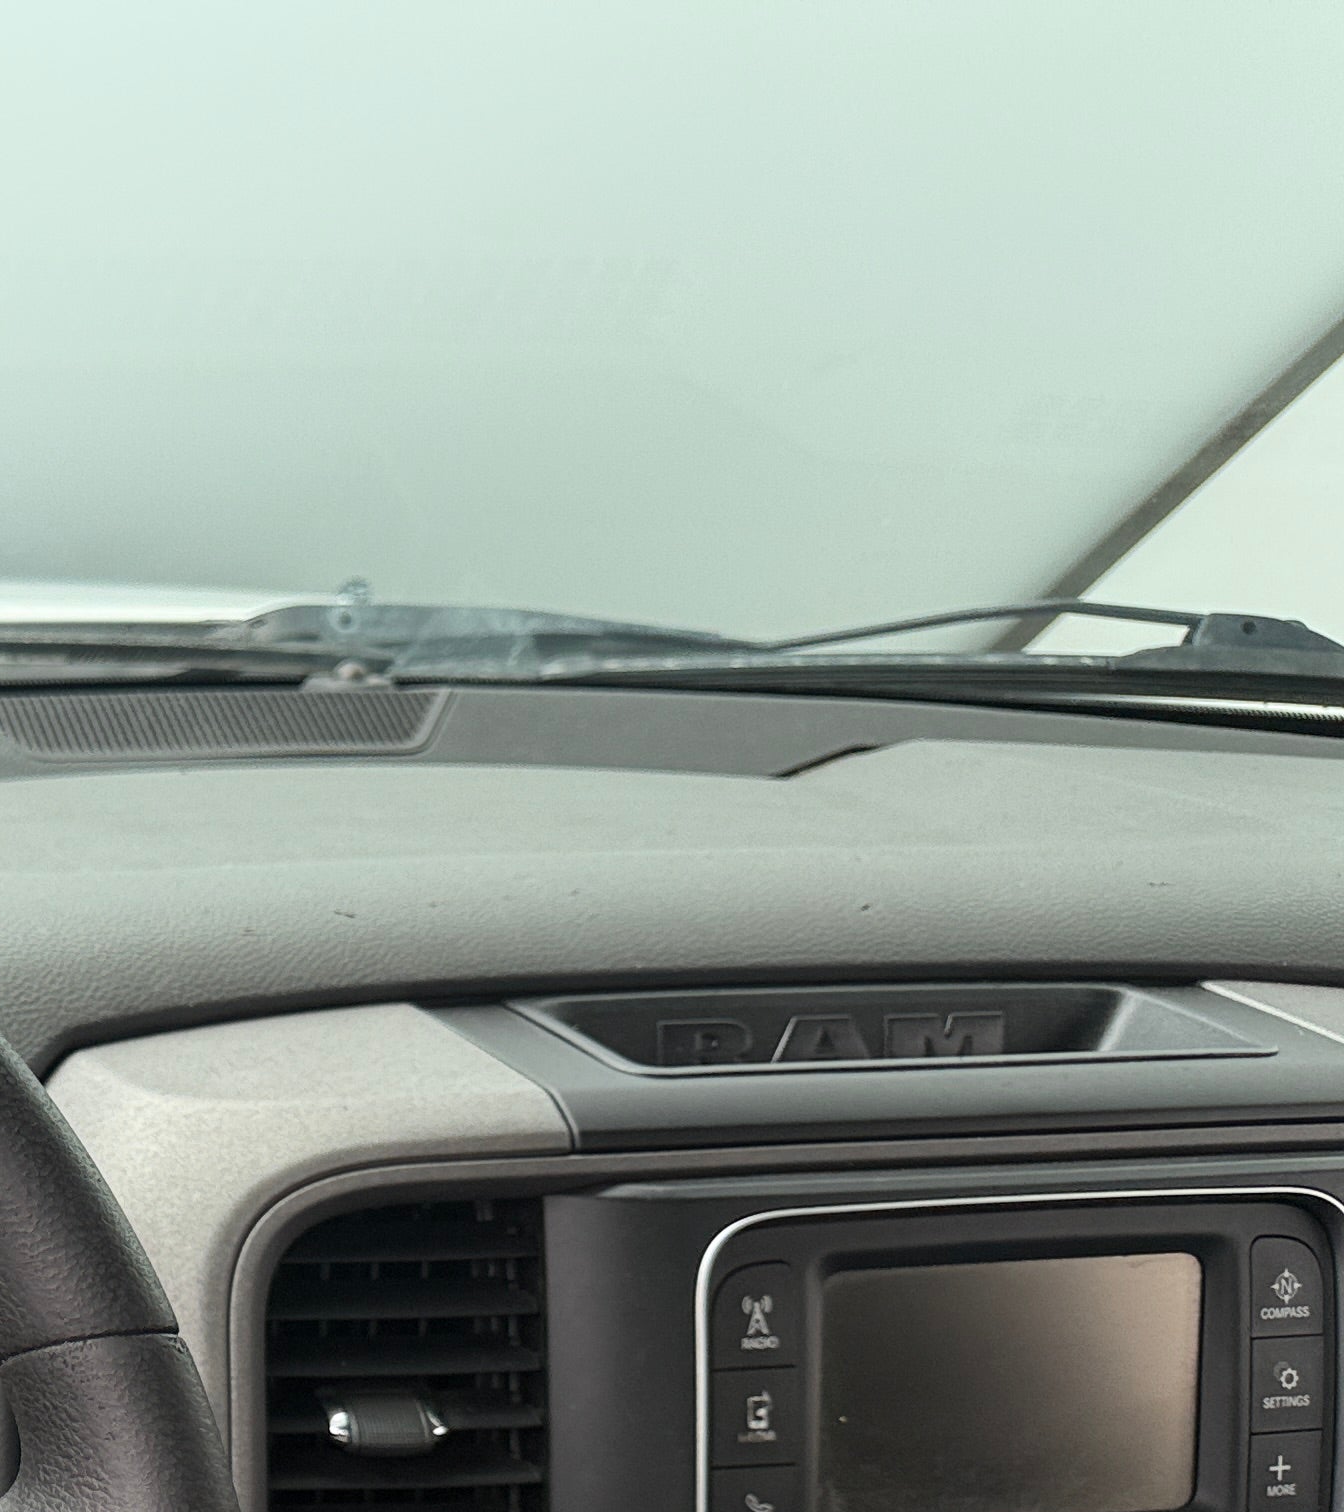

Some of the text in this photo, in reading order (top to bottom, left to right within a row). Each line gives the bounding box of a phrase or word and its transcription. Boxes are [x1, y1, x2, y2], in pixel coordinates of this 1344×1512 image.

[656, 1010, 1004, 1064] RAM
[1261, 1306, 1310, 1320] COMPASS
[1262, 1395, 1310, 1409] SETTINGS
[1267, 1483, 1297, 1497] MORE
